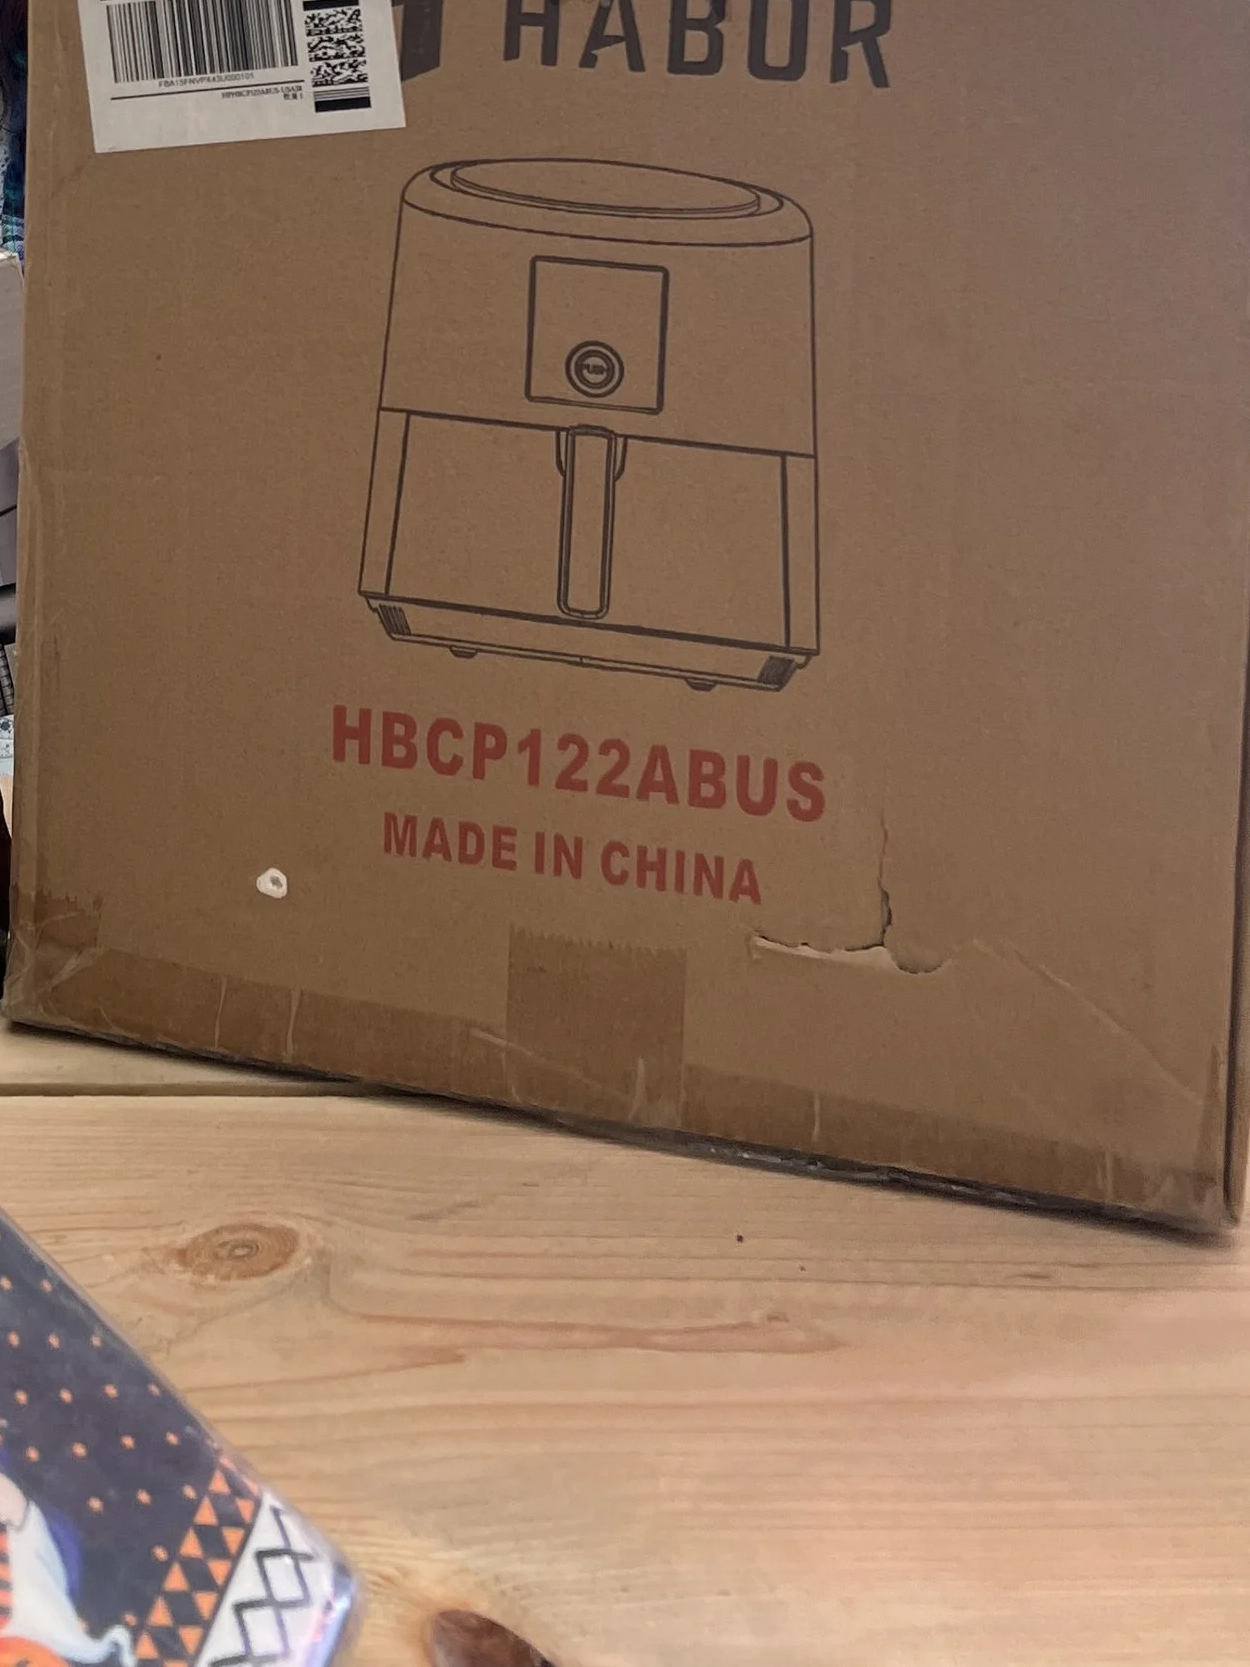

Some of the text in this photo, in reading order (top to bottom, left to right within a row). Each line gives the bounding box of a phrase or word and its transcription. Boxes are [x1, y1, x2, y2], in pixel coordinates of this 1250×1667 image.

[332, 704, 826, 822] HBCP122ABUS
[382, 811, 763, 905] MADE IN CHINA
